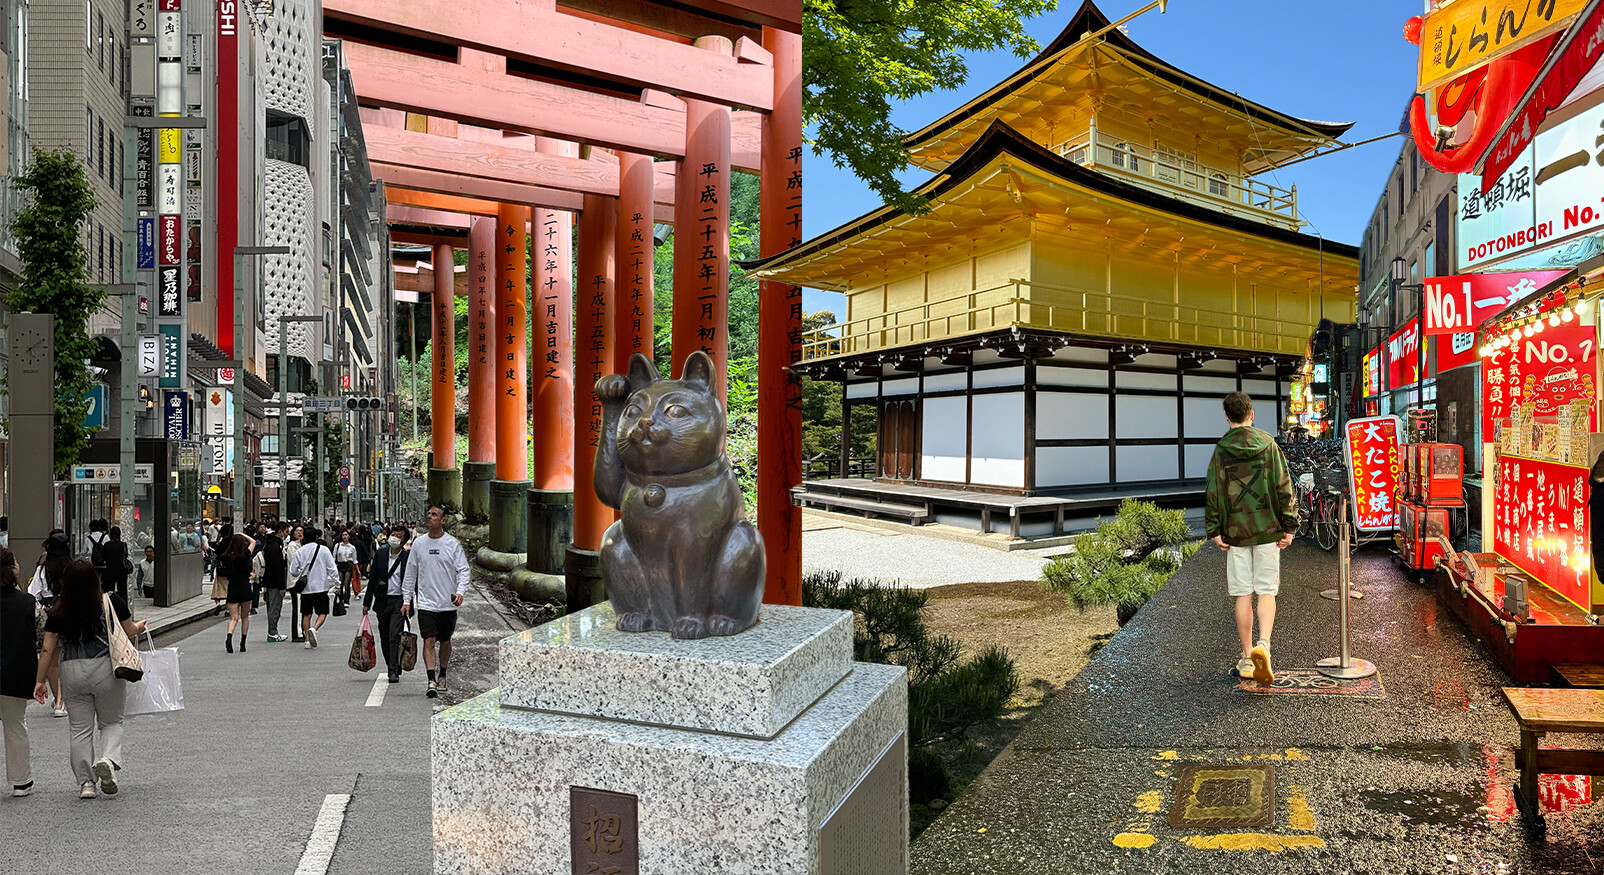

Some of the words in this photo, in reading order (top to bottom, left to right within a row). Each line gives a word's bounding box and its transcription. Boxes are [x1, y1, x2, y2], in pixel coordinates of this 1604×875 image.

[1461, 166, 1531, 221] 道頓堀
[1468, 220, 1553, 262] DOTONBORI
[1564, 196, 1604, 230] No.
[165, 219, 175, 262] おたからや
[163, 268, 178, 313] 星乃珈琲
[505, 225, 517, 397] 令和二年二月吉日建之
[630, 212, 645, 355] 平成二十七年九月吉
[1427, 281, 1473, 329] No.1
[1508, 340, 1521, 417] 番人気の個人
[1525, 339, 1593, 364] No.1
[1351, 439, 1366, 514] TAKOYAKI
[1363, 422, 1393, 513] 大たこ焼
[1386, 435, 1402, 511] TAKOYA
[580, 803, 623, 875] 招
